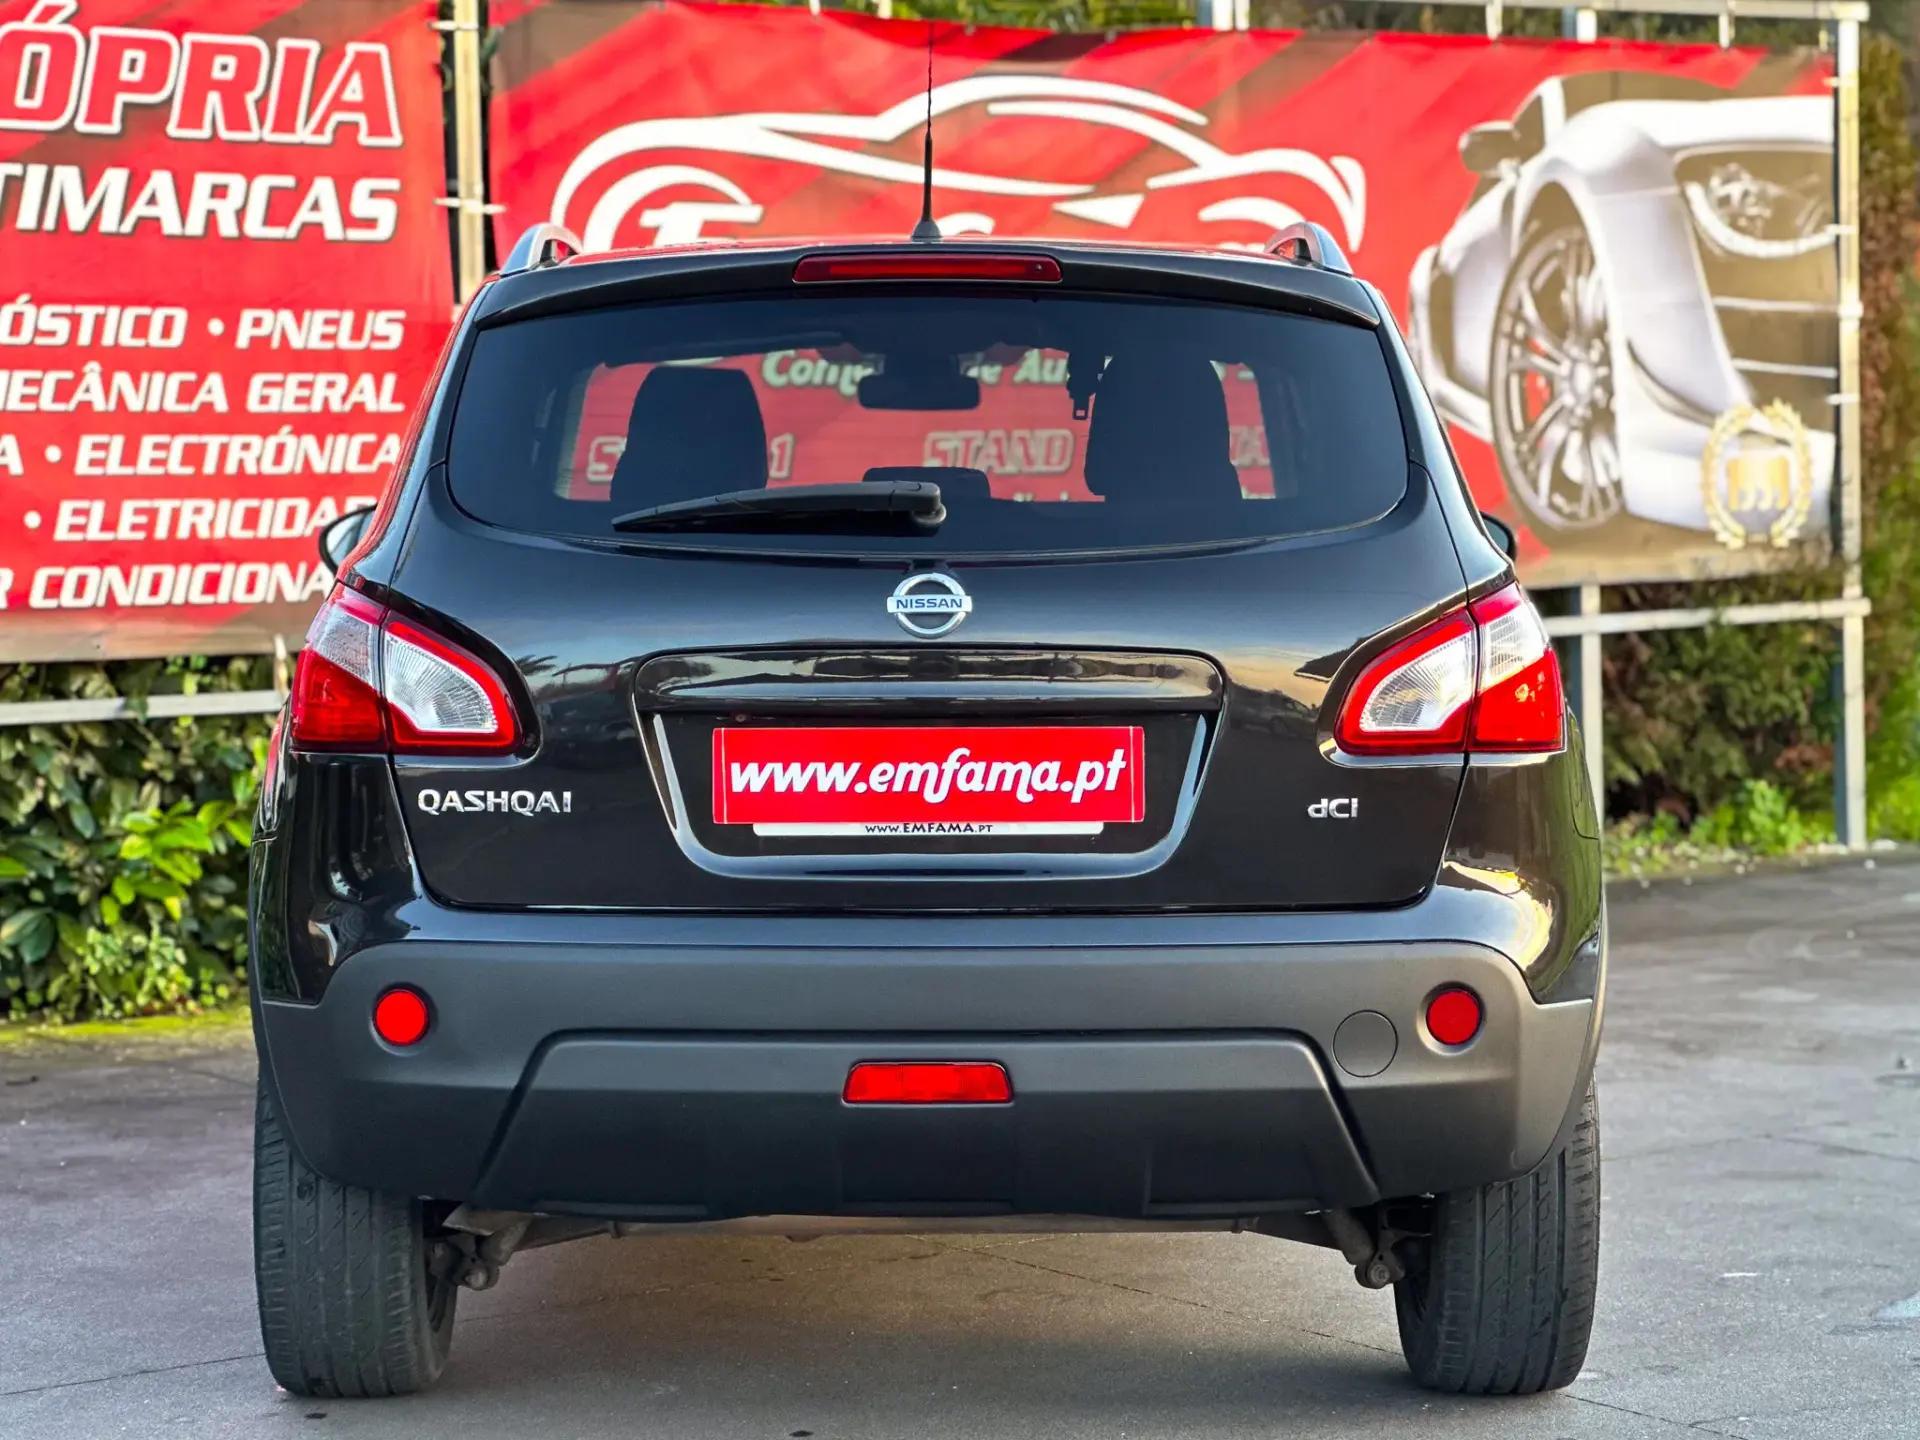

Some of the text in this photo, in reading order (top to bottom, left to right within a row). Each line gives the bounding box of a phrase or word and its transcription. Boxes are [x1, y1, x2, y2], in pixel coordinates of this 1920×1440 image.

[0, 0, 403, 147] ÓPRIA
[0, 294, 406, 350] ÓSTICO PNEUS
[0, 361, 405, 413] ECÂNICA GERAL
[74, 425, 401, 476] ELECTRÓNICA
[923, 428, 1074, 474] STAND
[53, 496, 378, 541] ELETRICIDA
[896, 598, 963, 609] NISSAN
[730, 747, 1127, 803] www.emfama.pt
[417, 788, 573, 817] QASHQAI
